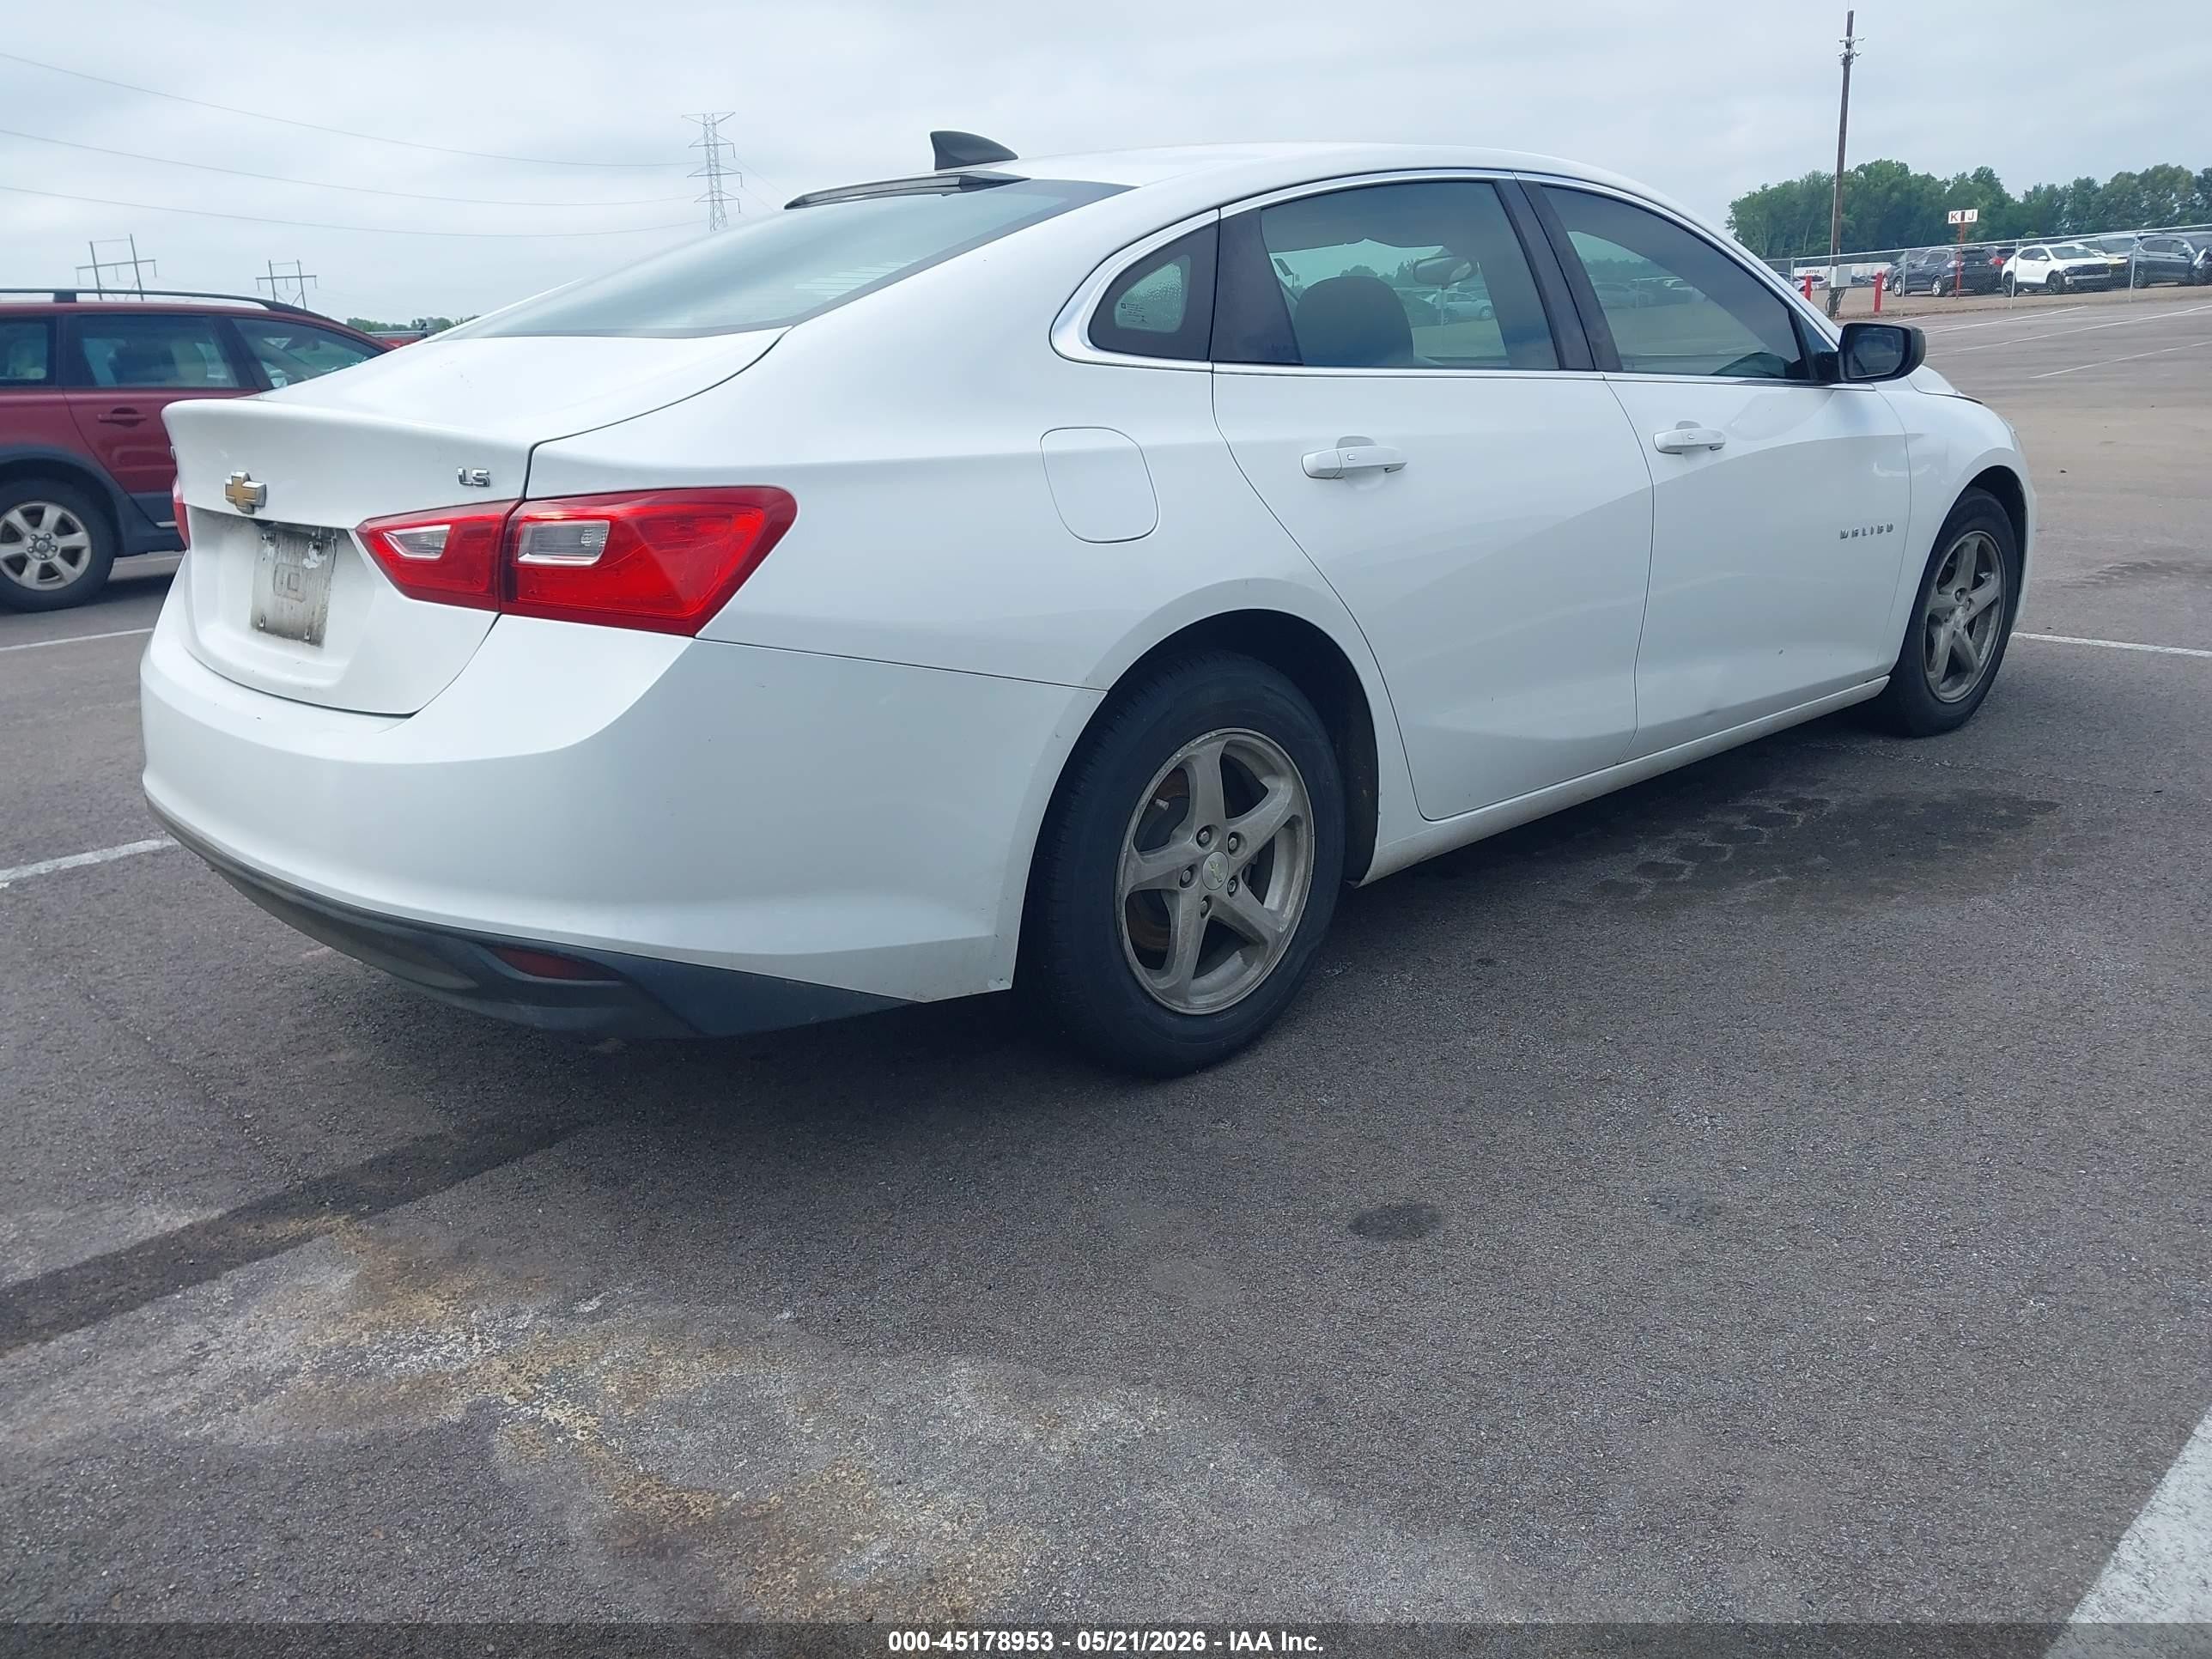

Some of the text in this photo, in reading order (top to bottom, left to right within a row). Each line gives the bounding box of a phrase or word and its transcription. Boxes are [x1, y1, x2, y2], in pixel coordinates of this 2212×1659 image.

[1950, 210, 1974, 222] K J
[457, 467, 490, 488] LS
